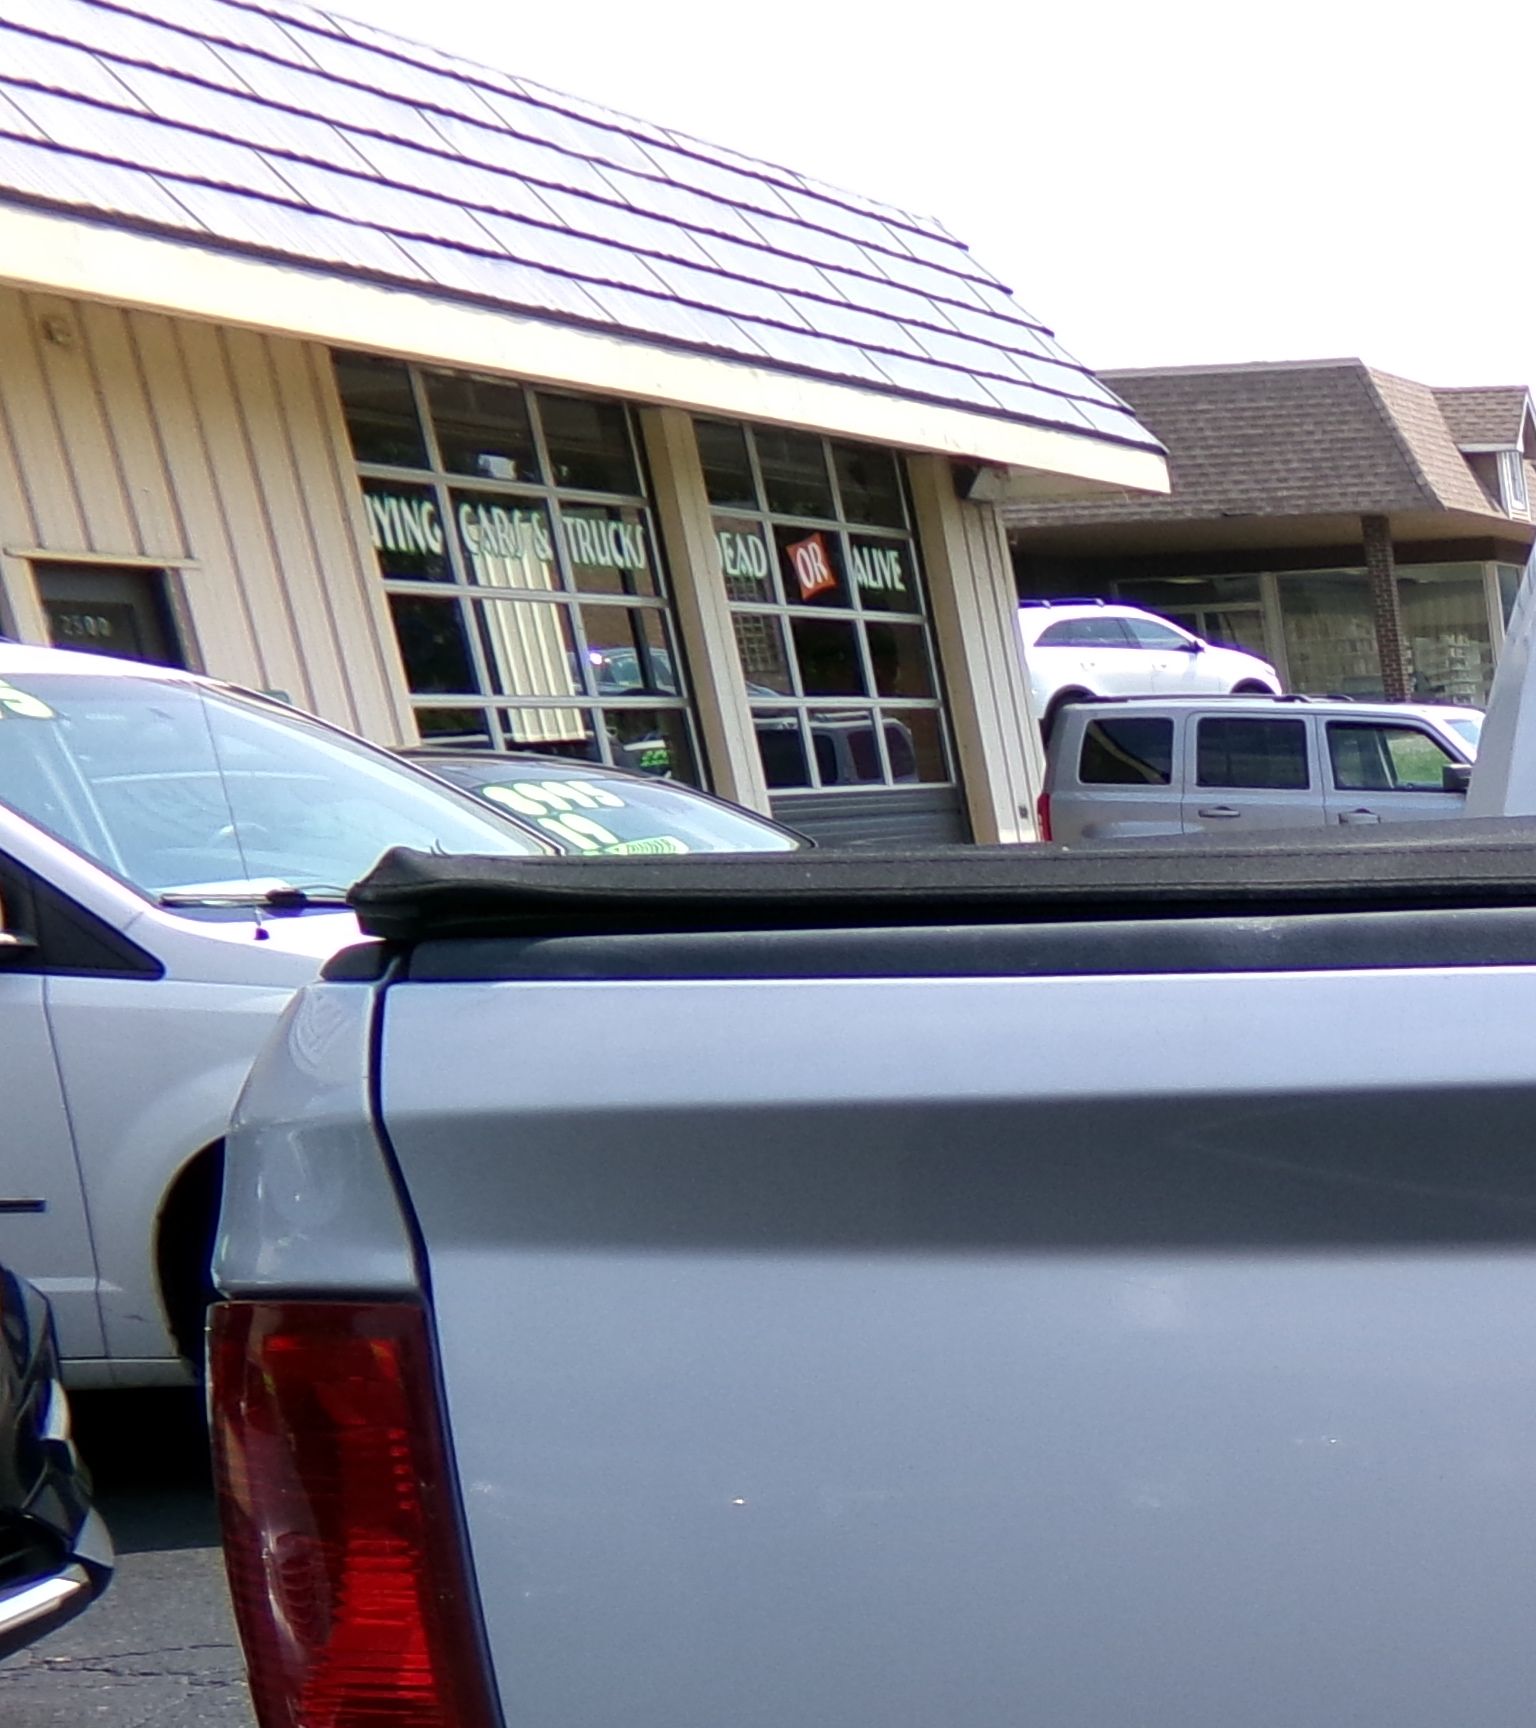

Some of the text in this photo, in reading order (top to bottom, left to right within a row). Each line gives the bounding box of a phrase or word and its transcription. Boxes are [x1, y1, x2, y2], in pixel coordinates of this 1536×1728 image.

[458, 502, 527, 559] CARS
[530, 511, 553, 560] &
[561, 516, 645, 568] TRUCKS
[794, 541, 829, 588] OR
[851, 545, 906, 592] ALIVE
